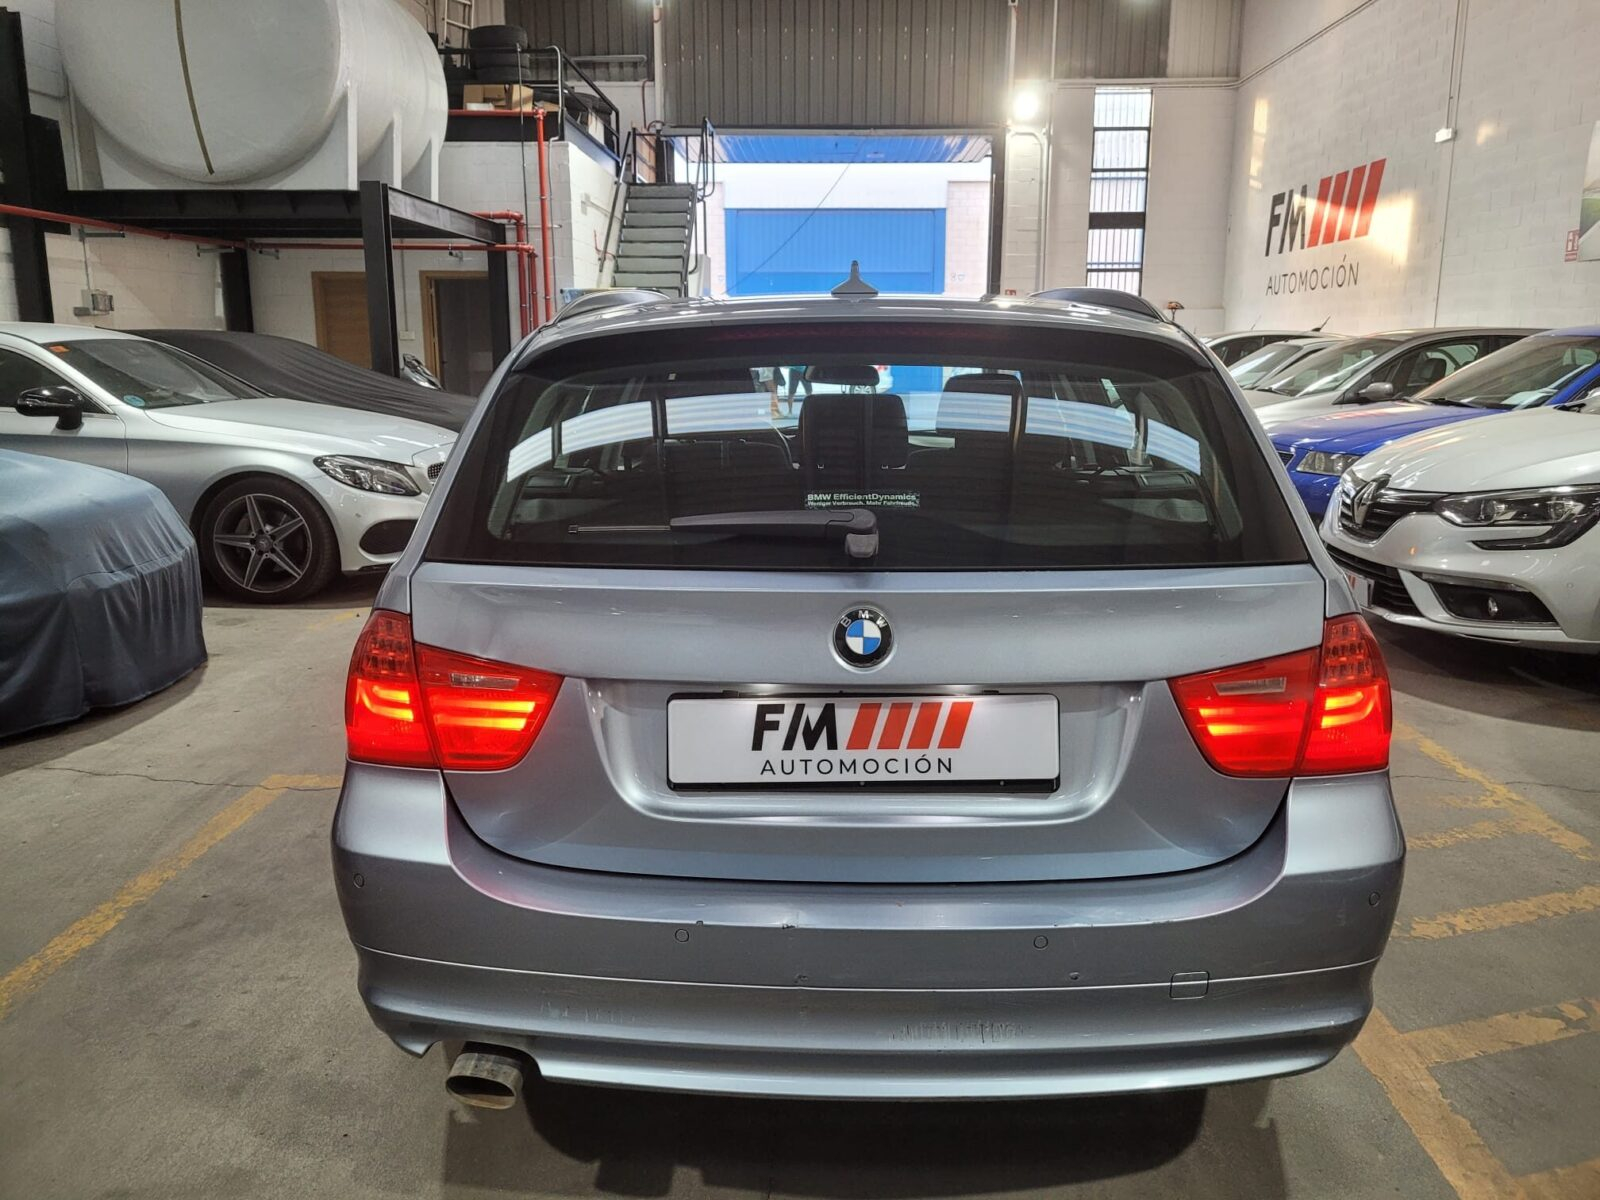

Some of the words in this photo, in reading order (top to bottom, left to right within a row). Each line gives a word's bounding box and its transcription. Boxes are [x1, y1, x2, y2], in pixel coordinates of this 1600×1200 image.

[1265, 184, 1308, 257] FM
[1265, 253, 1360, 296] AUTOMOCIÓN
[807, 493, 831, 501] BMW
[833, 493, 917, 502] EfficientDynamics
[840, 610, 888, 628] BMW
[751, 702, 838, 751] FM
[760, 754, 953, 776] AUTOMOCIÓN
